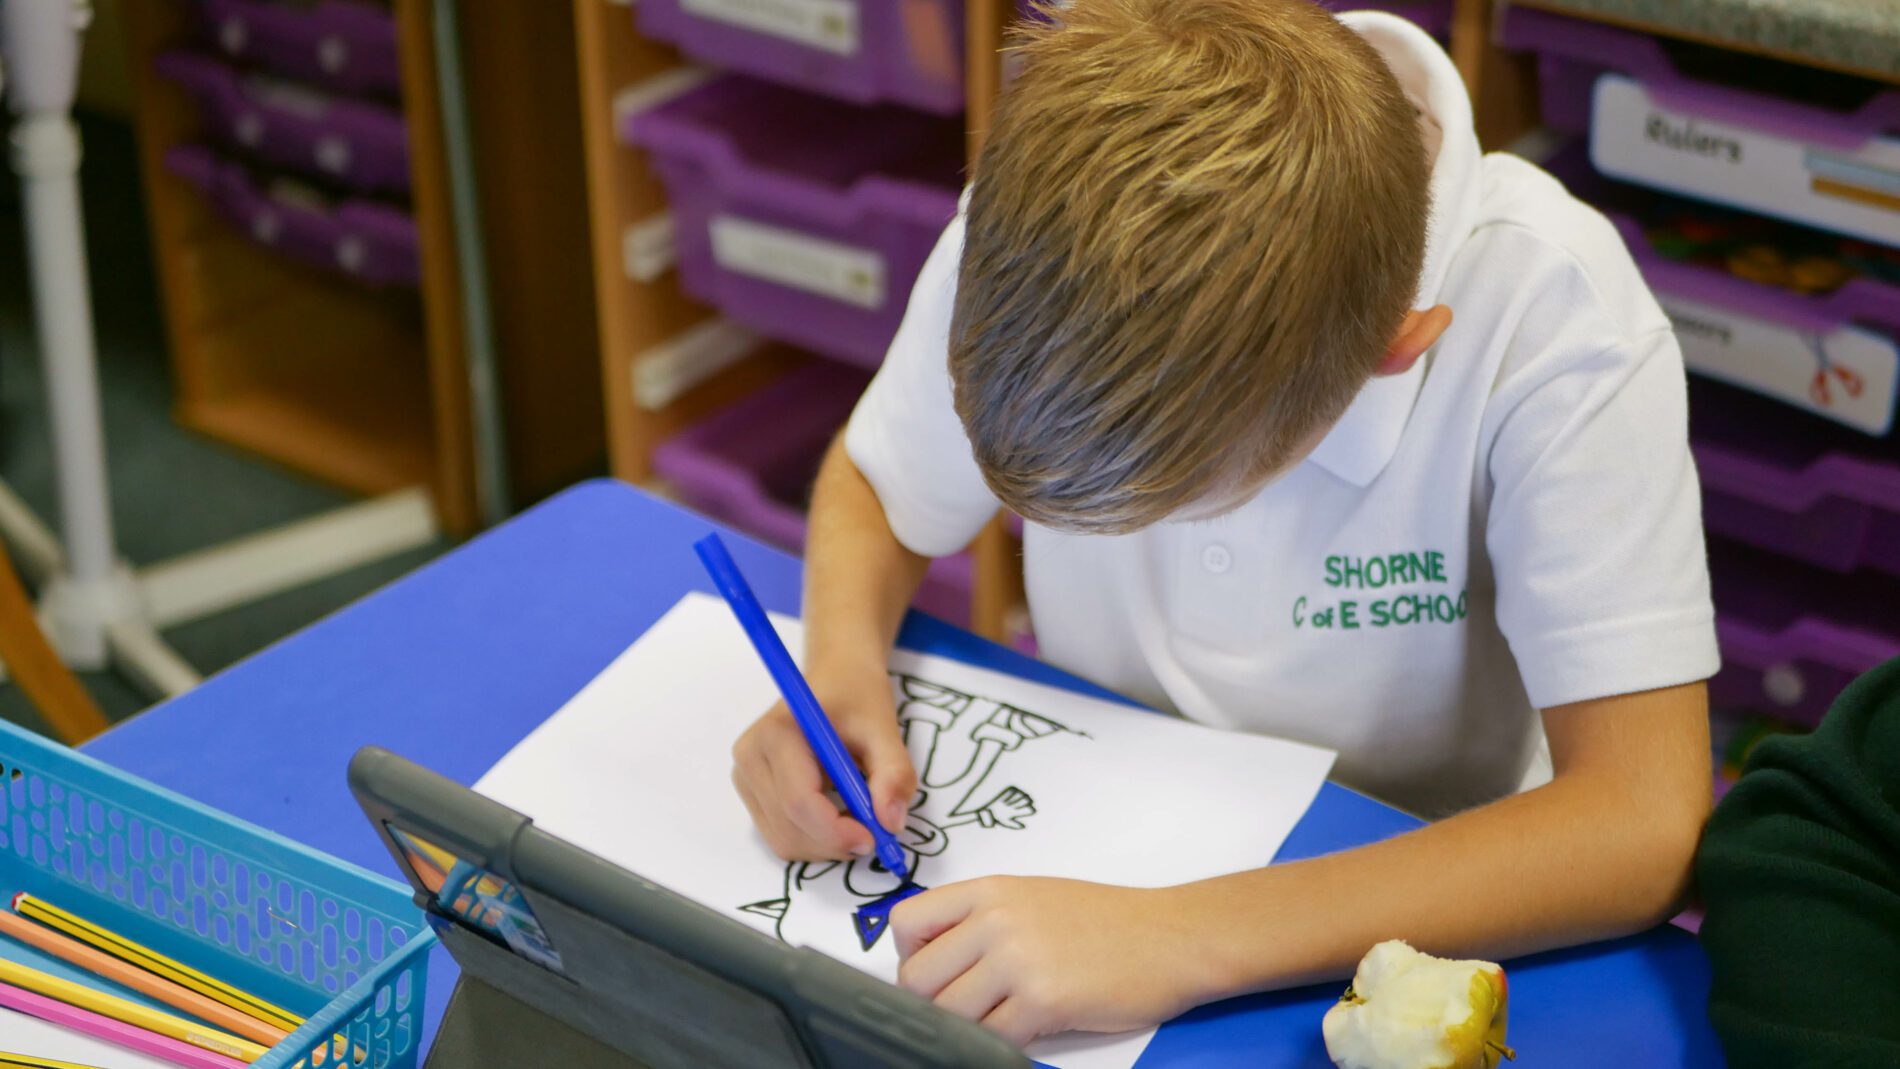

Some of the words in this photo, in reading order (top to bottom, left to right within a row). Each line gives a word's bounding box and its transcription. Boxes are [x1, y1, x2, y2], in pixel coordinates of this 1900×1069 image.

[1645, 113, 1743, 163] Rulers
[1324, 551, 1448, 589] SHORNE
[1293, 596, 1307, 629] C
[1311, 606, 1335, 629] of
[1339, 600, 1360, 629] E
